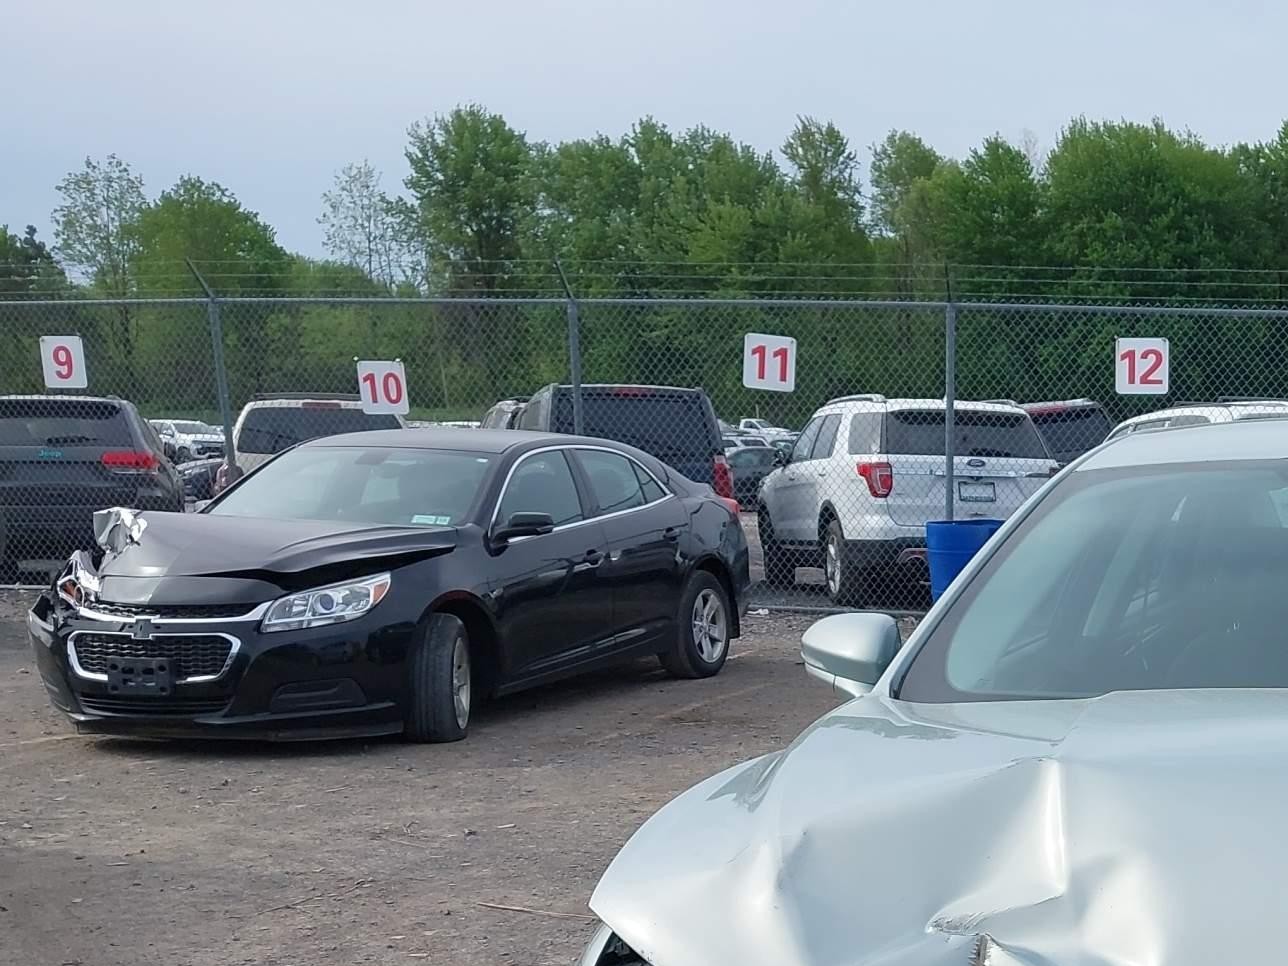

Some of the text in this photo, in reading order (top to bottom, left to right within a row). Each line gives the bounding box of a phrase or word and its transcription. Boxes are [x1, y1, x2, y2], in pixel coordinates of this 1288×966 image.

[53, 346, 73, 379] 9
[752, 345, 788, 382] 11
[1120, 349, 1163, 385] 12
[363, 372, 402, 404] 10
